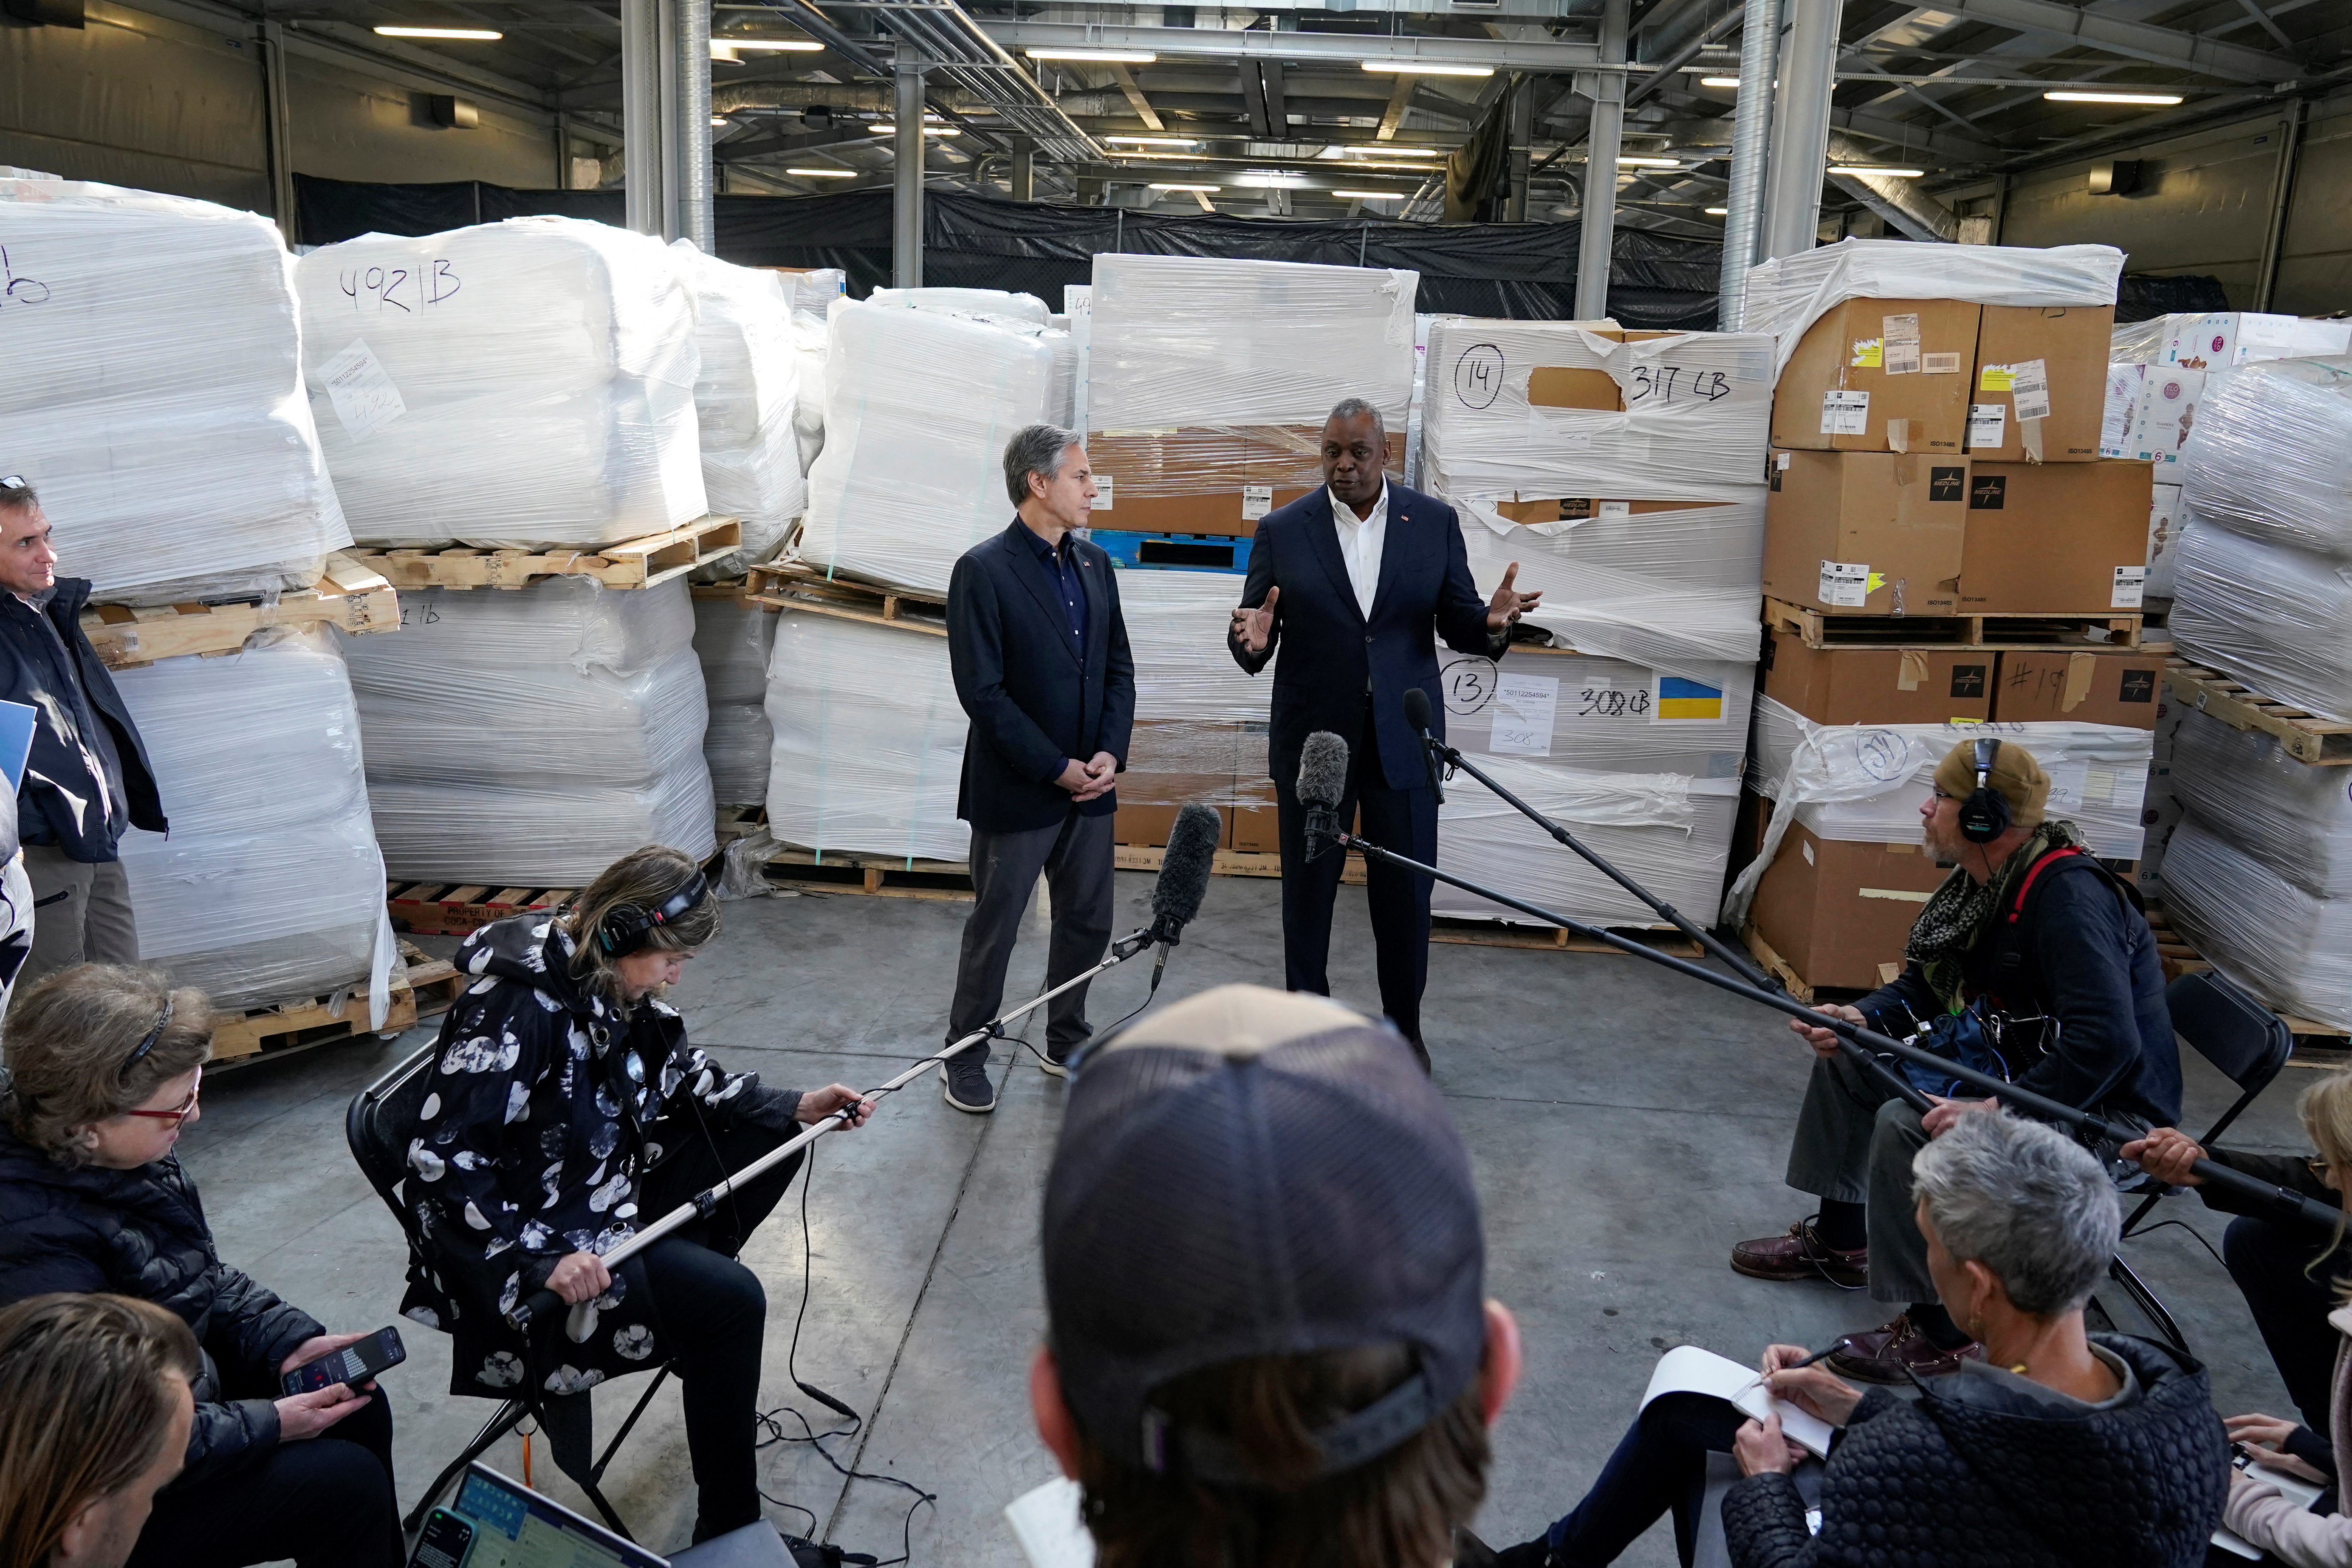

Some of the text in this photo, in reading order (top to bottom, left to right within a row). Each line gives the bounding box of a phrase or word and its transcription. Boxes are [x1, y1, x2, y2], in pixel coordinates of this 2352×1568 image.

[1468, 359, 1489, 391] 14
[1630, 367, 1731, 402] 317 LB
[355, 392, 395, 419] 492
[2155, 452, 2162, 461] 6
[1453, 673, 1482, 702] 13
[1578, 688, 1626, 716] 308
[1502, 730, 1533, 746] 308
[2149, 767, 2156, 776] 6
[2141, 871, 2149, 880] 6
[447, 906, 505, 918] PROPERTY OF
[445, 916, 494, 927] COCA-COL
